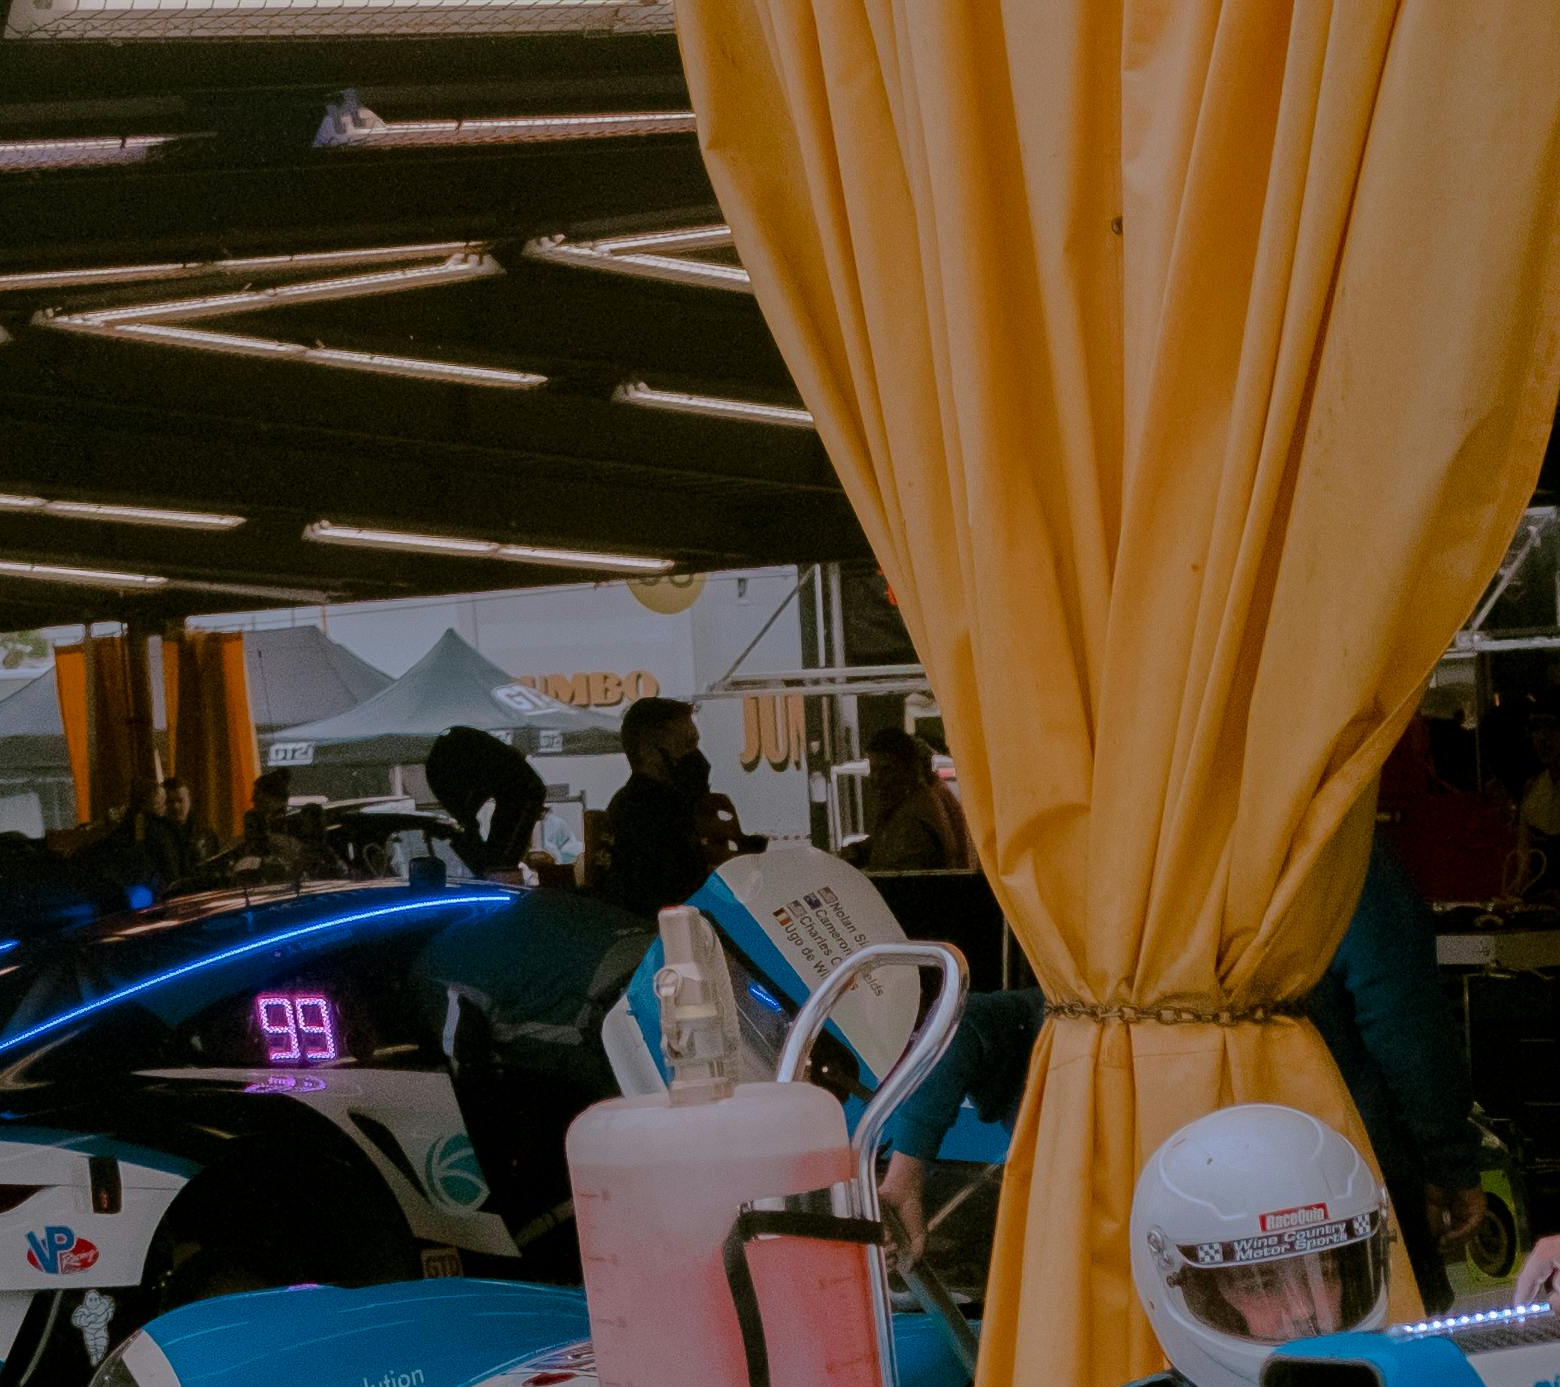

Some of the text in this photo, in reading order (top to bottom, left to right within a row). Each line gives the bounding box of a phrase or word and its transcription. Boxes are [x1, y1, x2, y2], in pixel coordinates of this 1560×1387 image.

[255, 996, 334, 1061] 99
[25, 1226, 75, 1275] VP
[1233, 1223, 1347, 1253] Wine Country
[1234, 1233, 1349, 1261] Motor Sports
